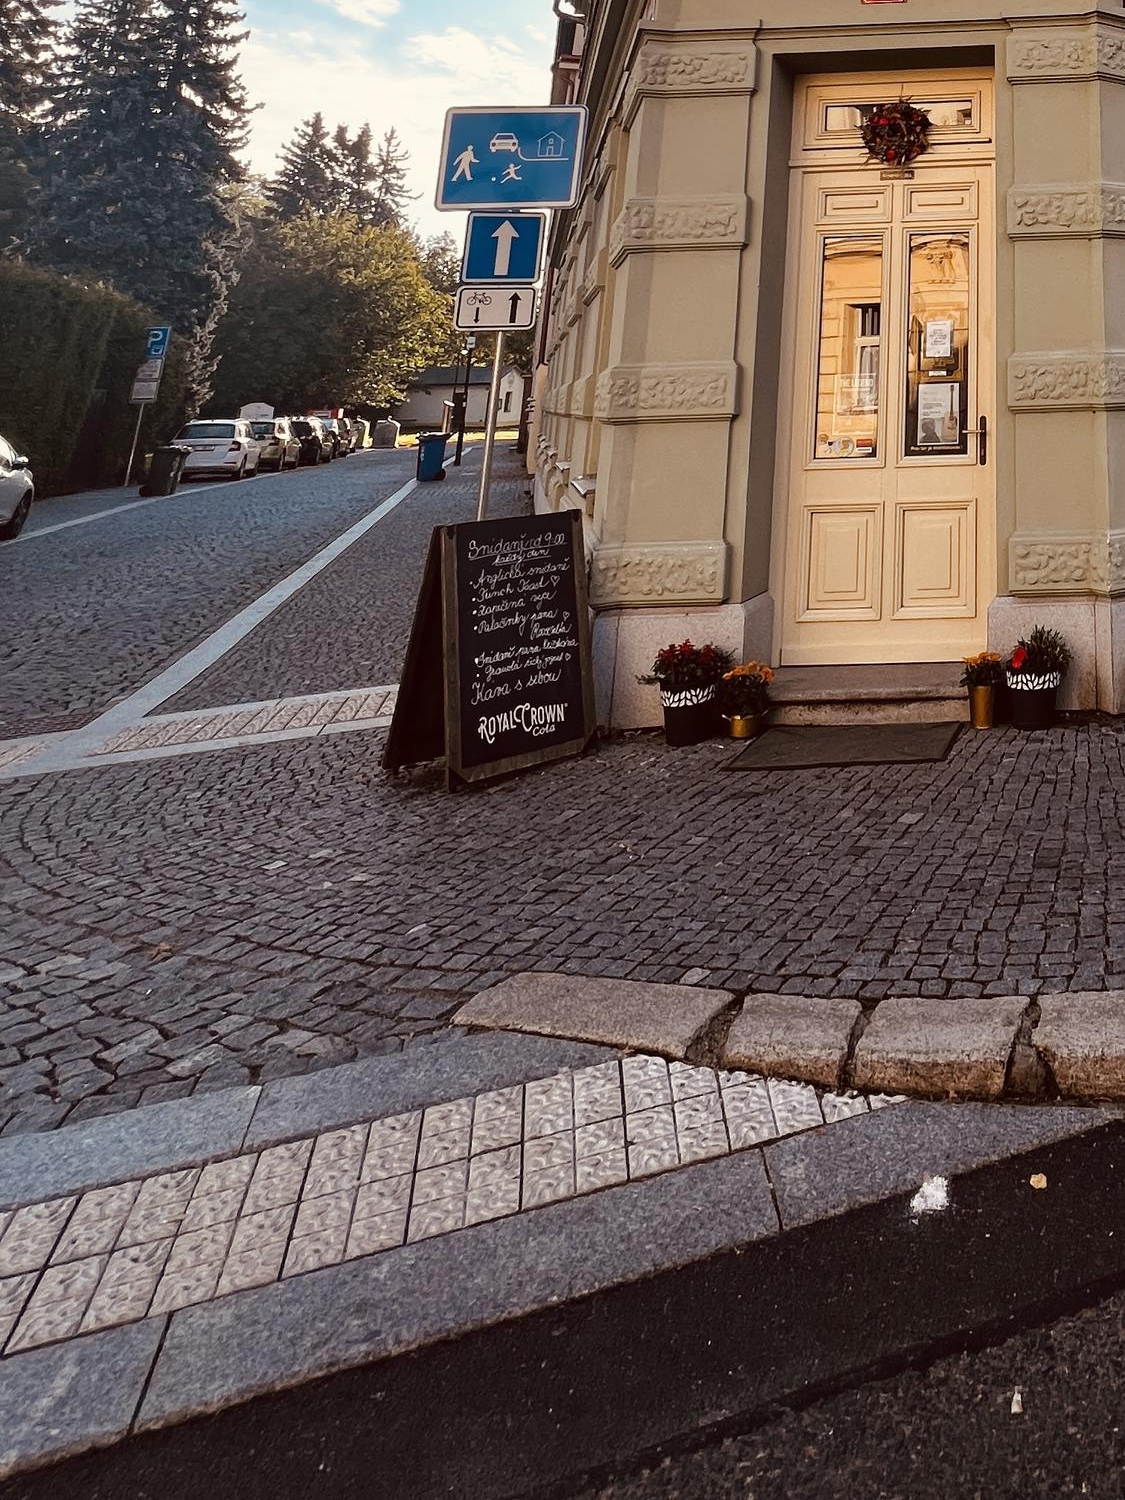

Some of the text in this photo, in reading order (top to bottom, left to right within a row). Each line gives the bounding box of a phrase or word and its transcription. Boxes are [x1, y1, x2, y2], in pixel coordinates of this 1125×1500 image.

[478, 703, 565, 744] ROYAL CROWN
[532, 723, 556, 737] Cola
